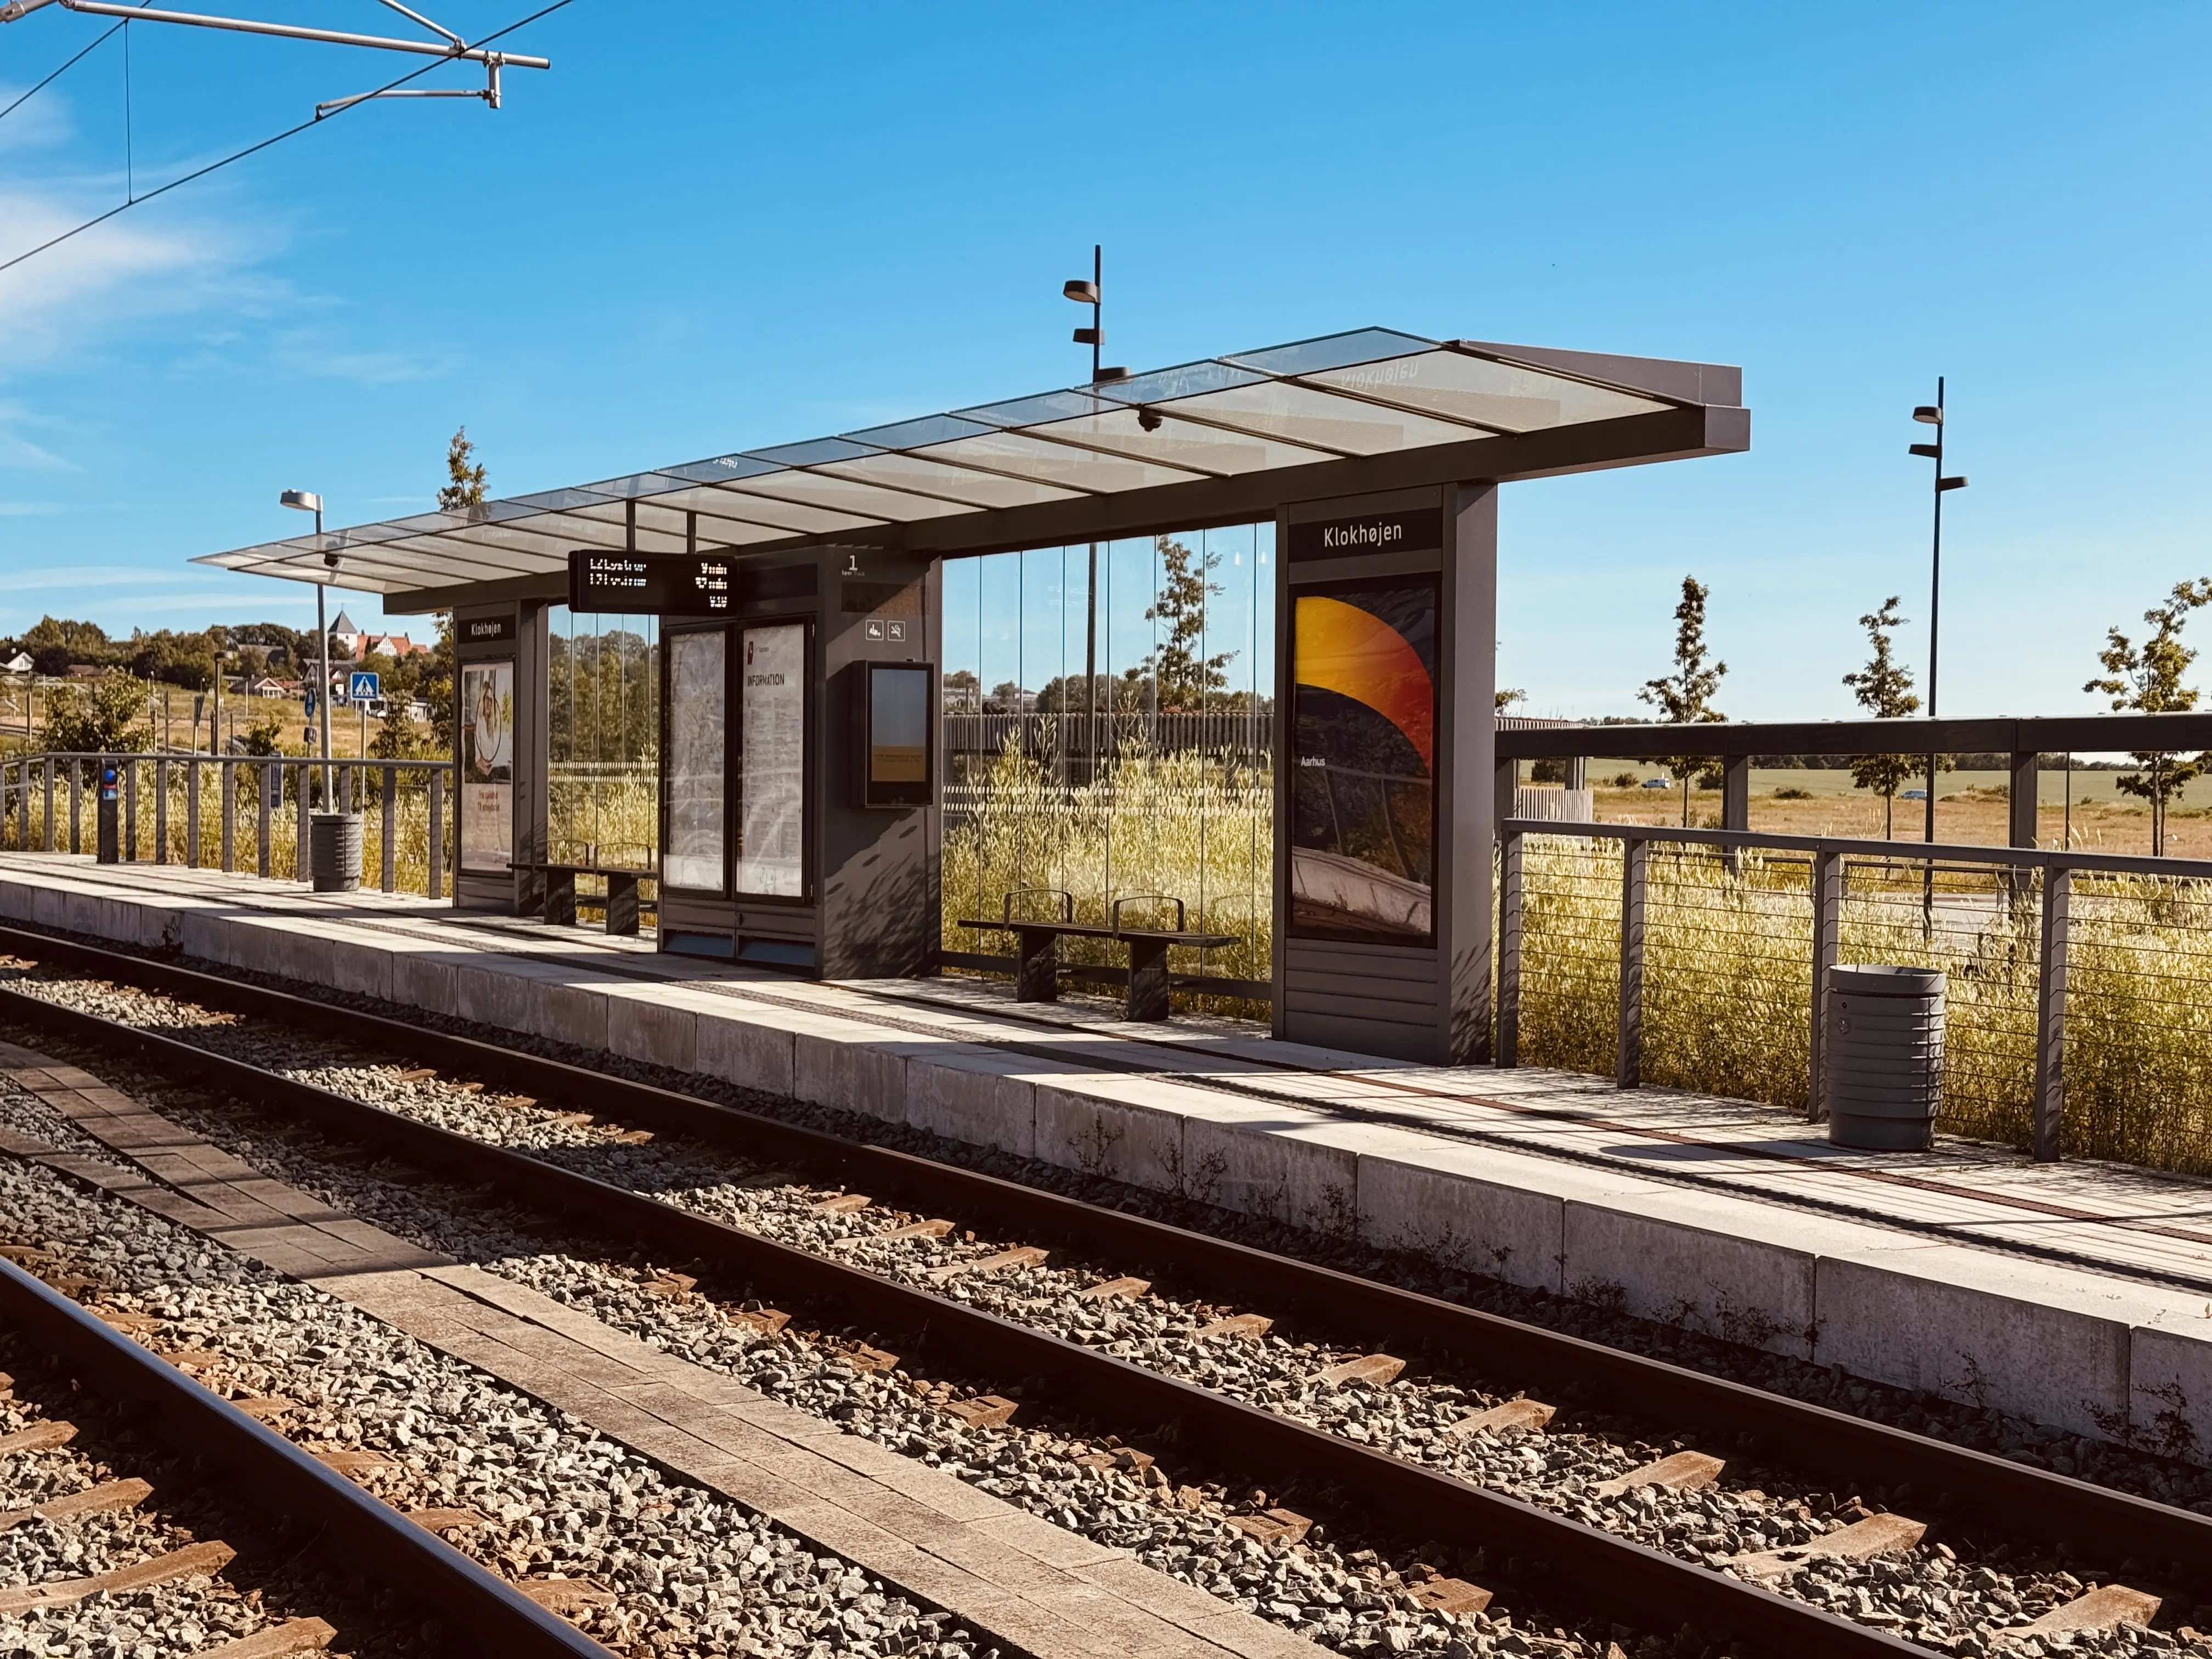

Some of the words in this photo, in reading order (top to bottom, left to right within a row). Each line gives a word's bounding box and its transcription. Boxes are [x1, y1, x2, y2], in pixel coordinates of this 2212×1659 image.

[1324, 521, 1402, 548] Klokhøjen
[849, 555, 858, 571] 1
[471, 620, 501, 638] Klokhøjen
[747, 673, 785, 687] INFORMATION
[1300, 755, 1326, 767] Aarhus
